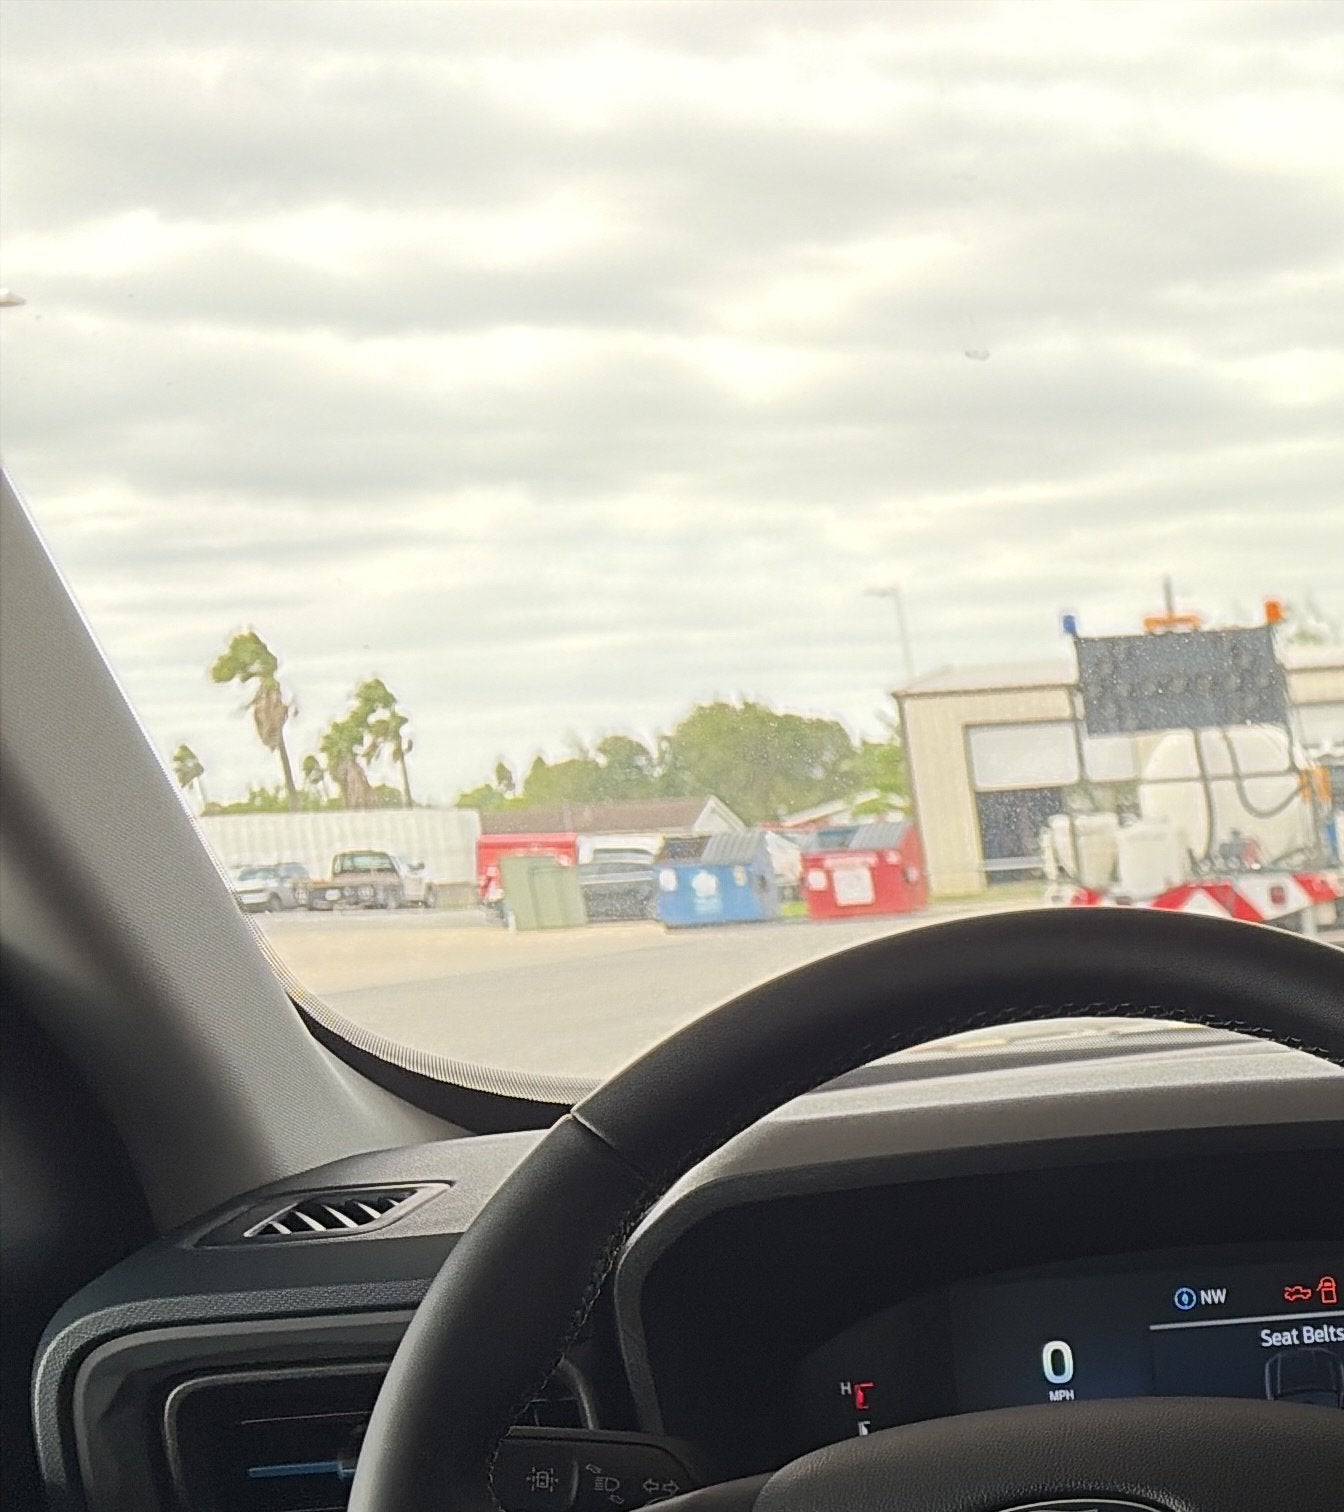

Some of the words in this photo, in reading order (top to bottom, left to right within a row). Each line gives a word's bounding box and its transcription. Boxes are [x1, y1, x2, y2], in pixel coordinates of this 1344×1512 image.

[1200, 1288, 1227, 1305] NW
[1260, 1329, 1300, 1347] Seat
[1043, 1340, 1074, 1384] 0
[840, 1382, 852, 1396] H
[1049, 1388, 1075, 1402] MPH
